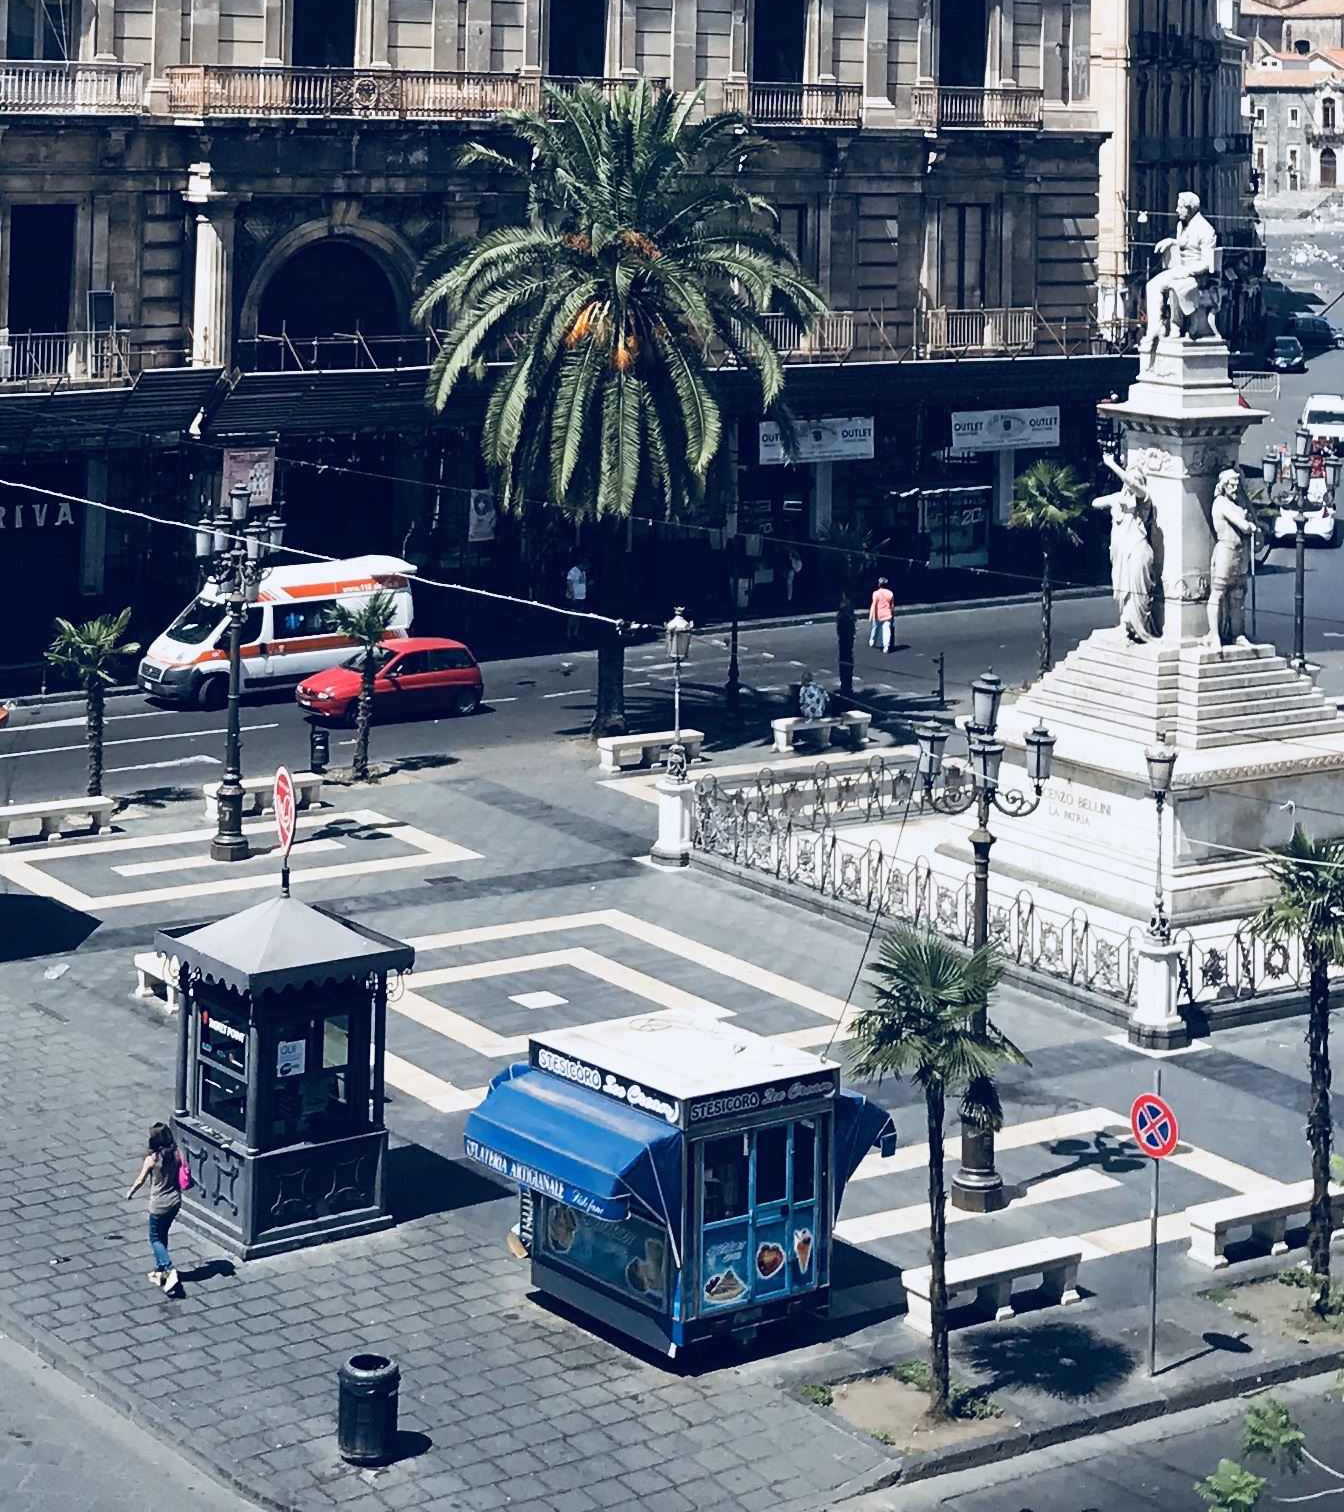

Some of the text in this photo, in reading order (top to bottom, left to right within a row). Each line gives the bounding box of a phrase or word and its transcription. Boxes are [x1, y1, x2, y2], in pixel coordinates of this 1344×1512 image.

[954, 422, 983, 431] OUTLET
[1029, 417, 1058, 427] OUTLET
[842, 429, 872, 438] OUTLET
[1049, 805, 1090, 826] LA PATRIA
[1078, 797, 1111, 816] BELLINI
[539, 1049, 601, 1090] STESICORO
[691, 1092, 760, 1120] STESICORO
[761, 1087, 786, 1105] Ice
[511, 1163, 564, 1199] ARTIGIANALE
